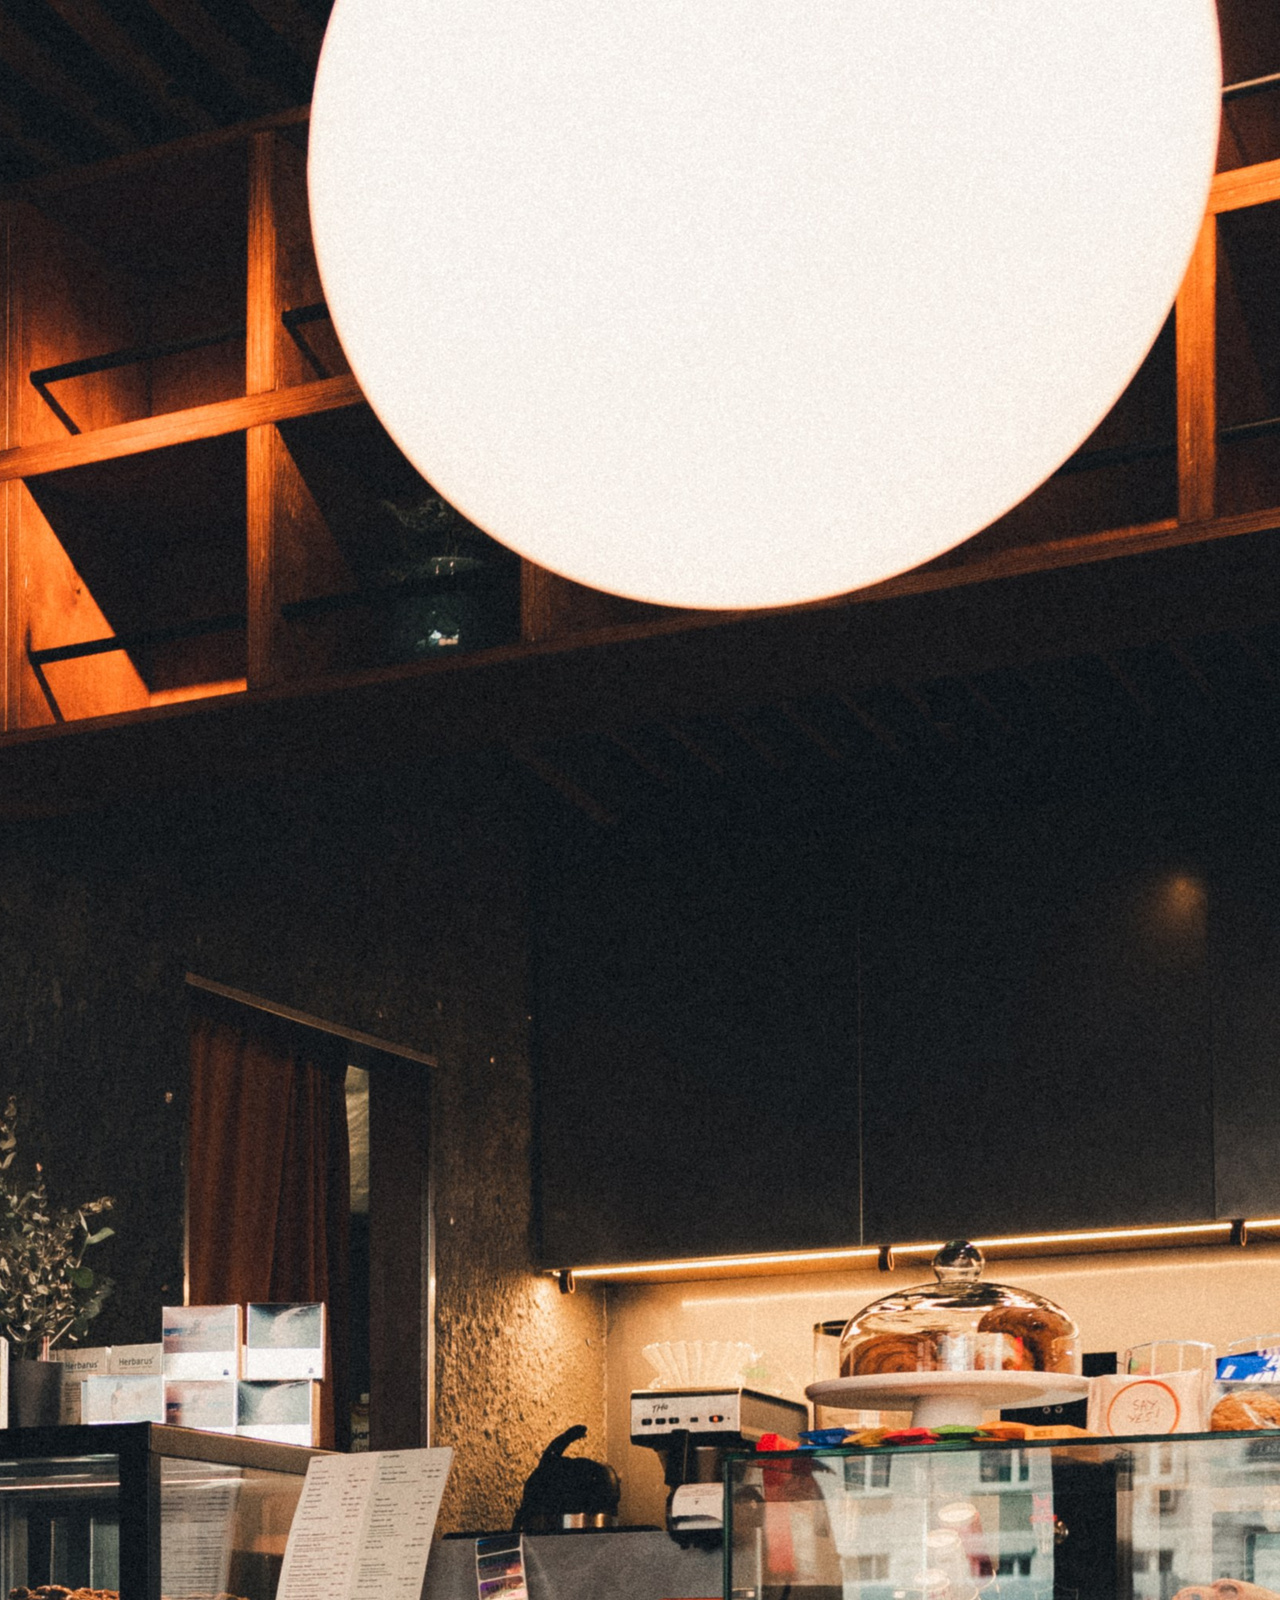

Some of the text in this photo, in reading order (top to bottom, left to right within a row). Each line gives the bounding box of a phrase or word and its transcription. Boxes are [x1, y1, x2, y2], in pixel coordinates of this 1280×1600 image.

[65, 1360, 98, 1370] Herbarus
[119, 1357, 153, 1366] Herbarus
[1132, 1399, 1159, 1411] SAY
[1128, 1408, 1161, 1425] YES!
